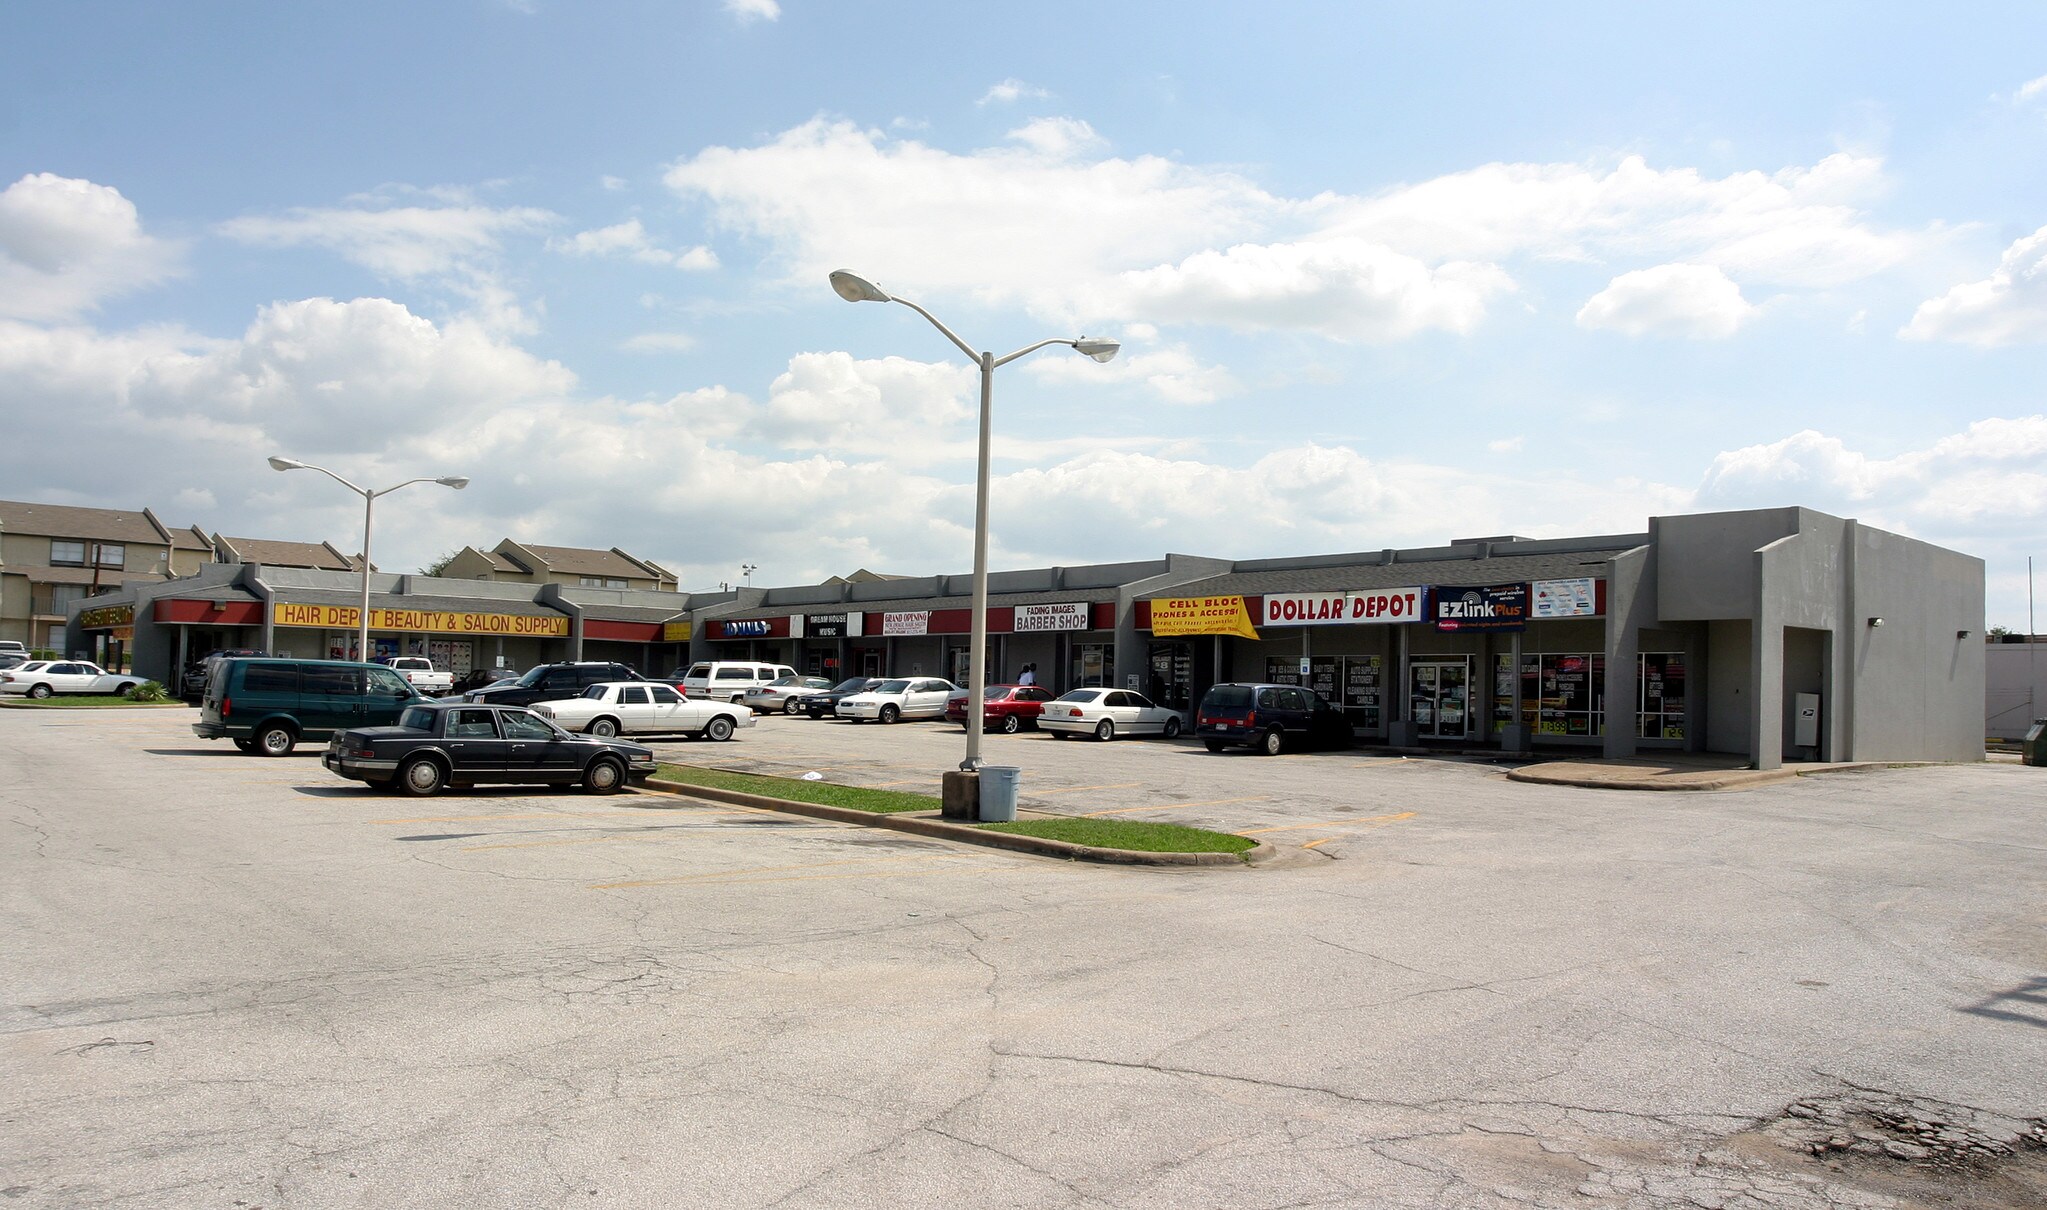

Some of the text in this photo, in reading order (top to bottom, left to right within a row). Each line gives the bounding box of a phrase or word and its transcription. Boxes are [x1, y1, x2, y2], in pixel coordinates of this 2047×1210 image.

[1169, 598, 1241, 609] CELL BLOC
[1270, 594, 1415, 620] DOLLAR DEPOT
[1027, 605, 1076, 615] FADING IMAGES
[1153, 610, 1187, 618] PHONES
[285, 605, 563, 634] HAIR DEPT BEAUTY & SALON SUPPLY
[884, 611, 927, 622] GRAND OPENING
[1017, 615, 1086, 630] BARBER SHOP
